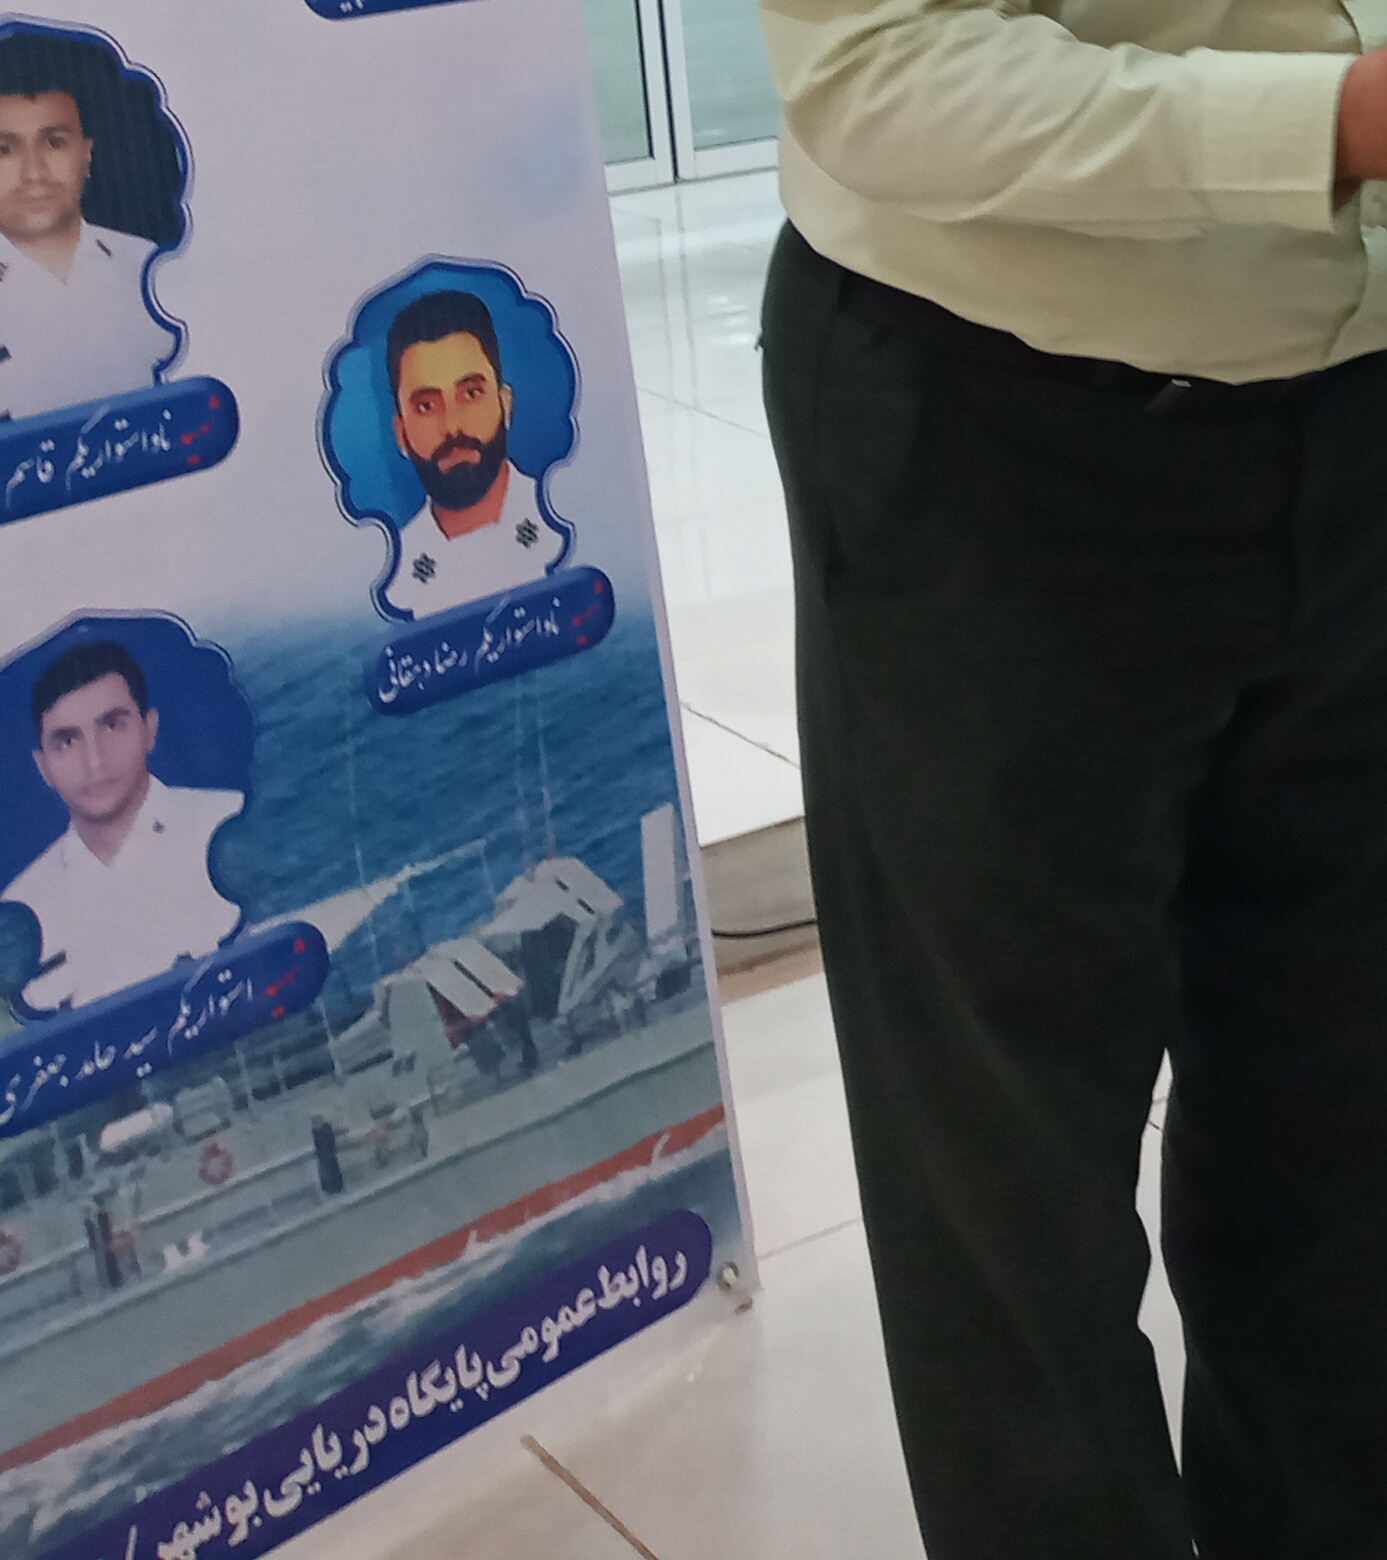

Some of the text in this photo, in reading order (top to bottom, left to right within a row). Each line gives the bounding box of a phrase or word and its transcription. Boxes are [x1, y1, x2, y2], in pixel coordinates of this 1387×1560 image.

[5, 438, 55, 508] قاسم
[434, 641, 468, 674] رضا
[123, 1026, 158, 1078] سید
[597, 1244, 688, 1308] روابط
[486, 1287, 597, 1388] عمومی
[389, 1343, 490, 1430] پایگاه
[263, 1404, 387, 1518] دریایی
